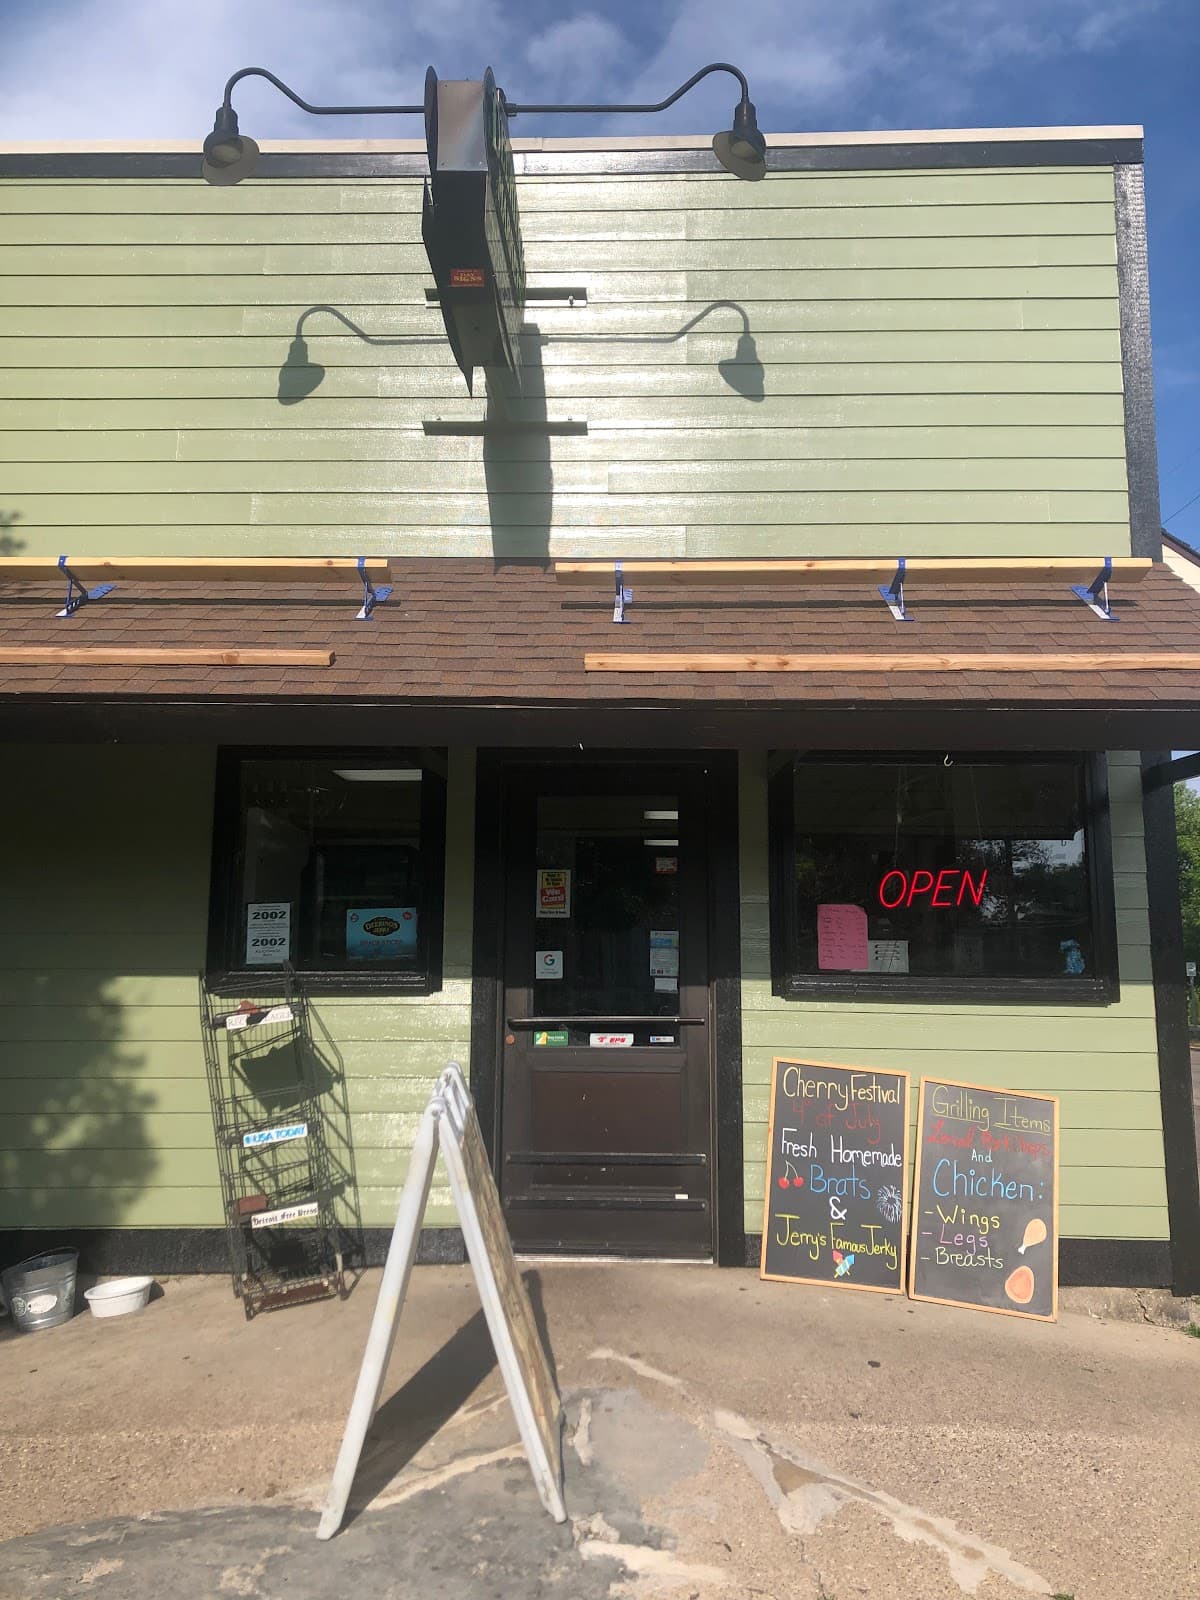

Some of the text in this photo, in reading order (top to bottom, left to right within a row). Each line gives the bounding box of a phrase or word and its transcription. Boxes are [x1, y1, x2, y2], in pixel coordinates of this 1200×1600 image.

[879, 869, 988, 909] OPEN
[251, 910, 287, 920] 2002
[251, 937, 286, 947] 2002
[783, 1066, 901, 1111] Cherry Festival
[932, 1085, 1051, 1133] Grilling Items
[781, 1127, 903, 1168] Fresh Homemade
[971, 1148, 993, 1163] And
[809, 1163, 872, 1200] Brats
[932, 1158, 1044, 1202] Chicken:
[828, 1196, 848, 1220] &
[936, 1204, 1000, 1235] Wings
[774, 1213, 899, 1271] Jerry's Famous Jerky
[939, 1223, 989, 1255] Legs
[934, 1246, 1004, 1269] Breasts
